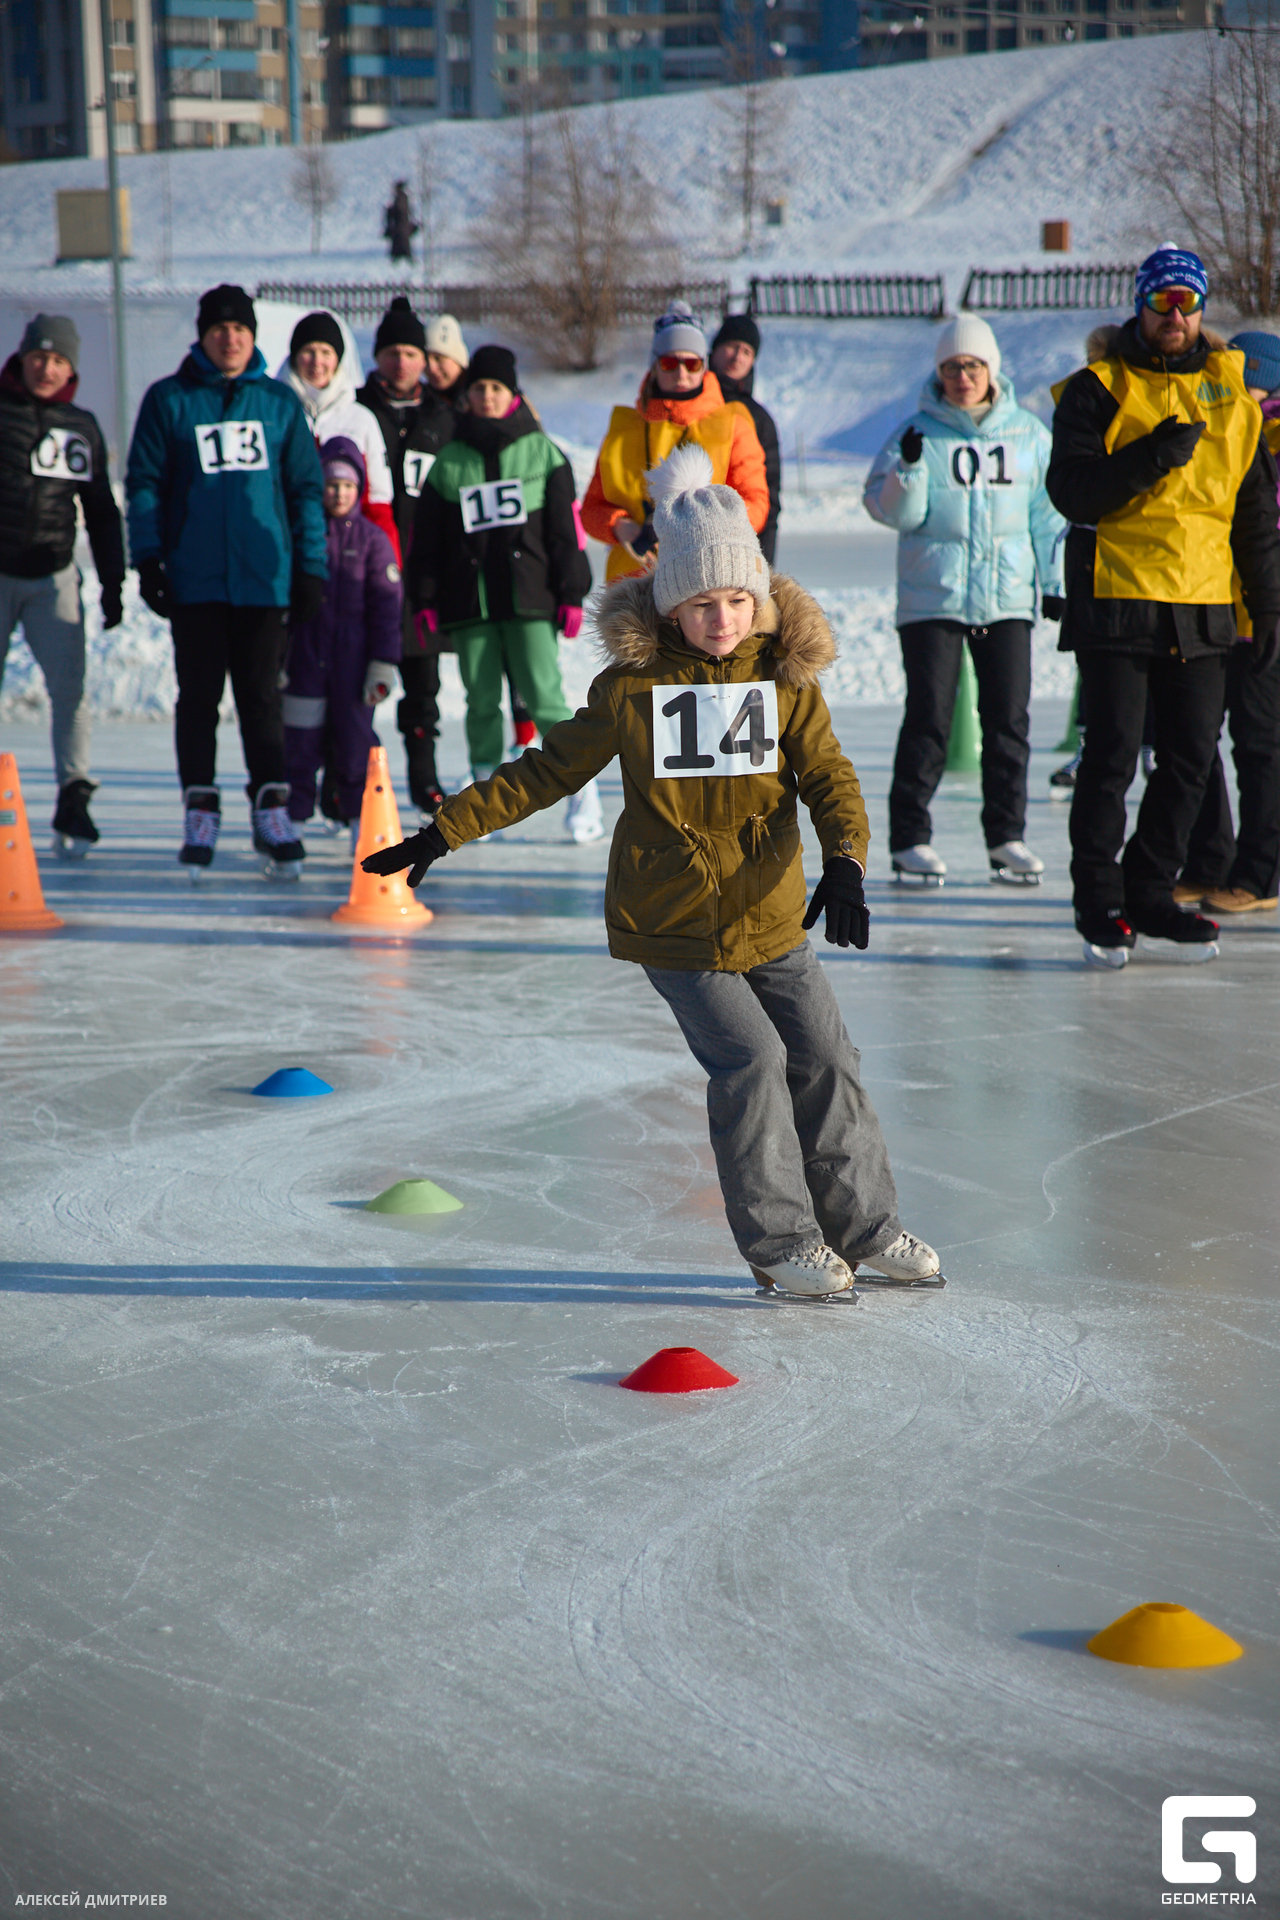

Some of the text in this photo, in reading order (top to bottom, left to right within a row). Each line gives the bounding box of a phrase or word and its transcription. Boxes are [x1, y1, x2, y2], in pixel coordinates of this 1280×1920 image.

[36, 431, 88, 473] 06
[204, 427, 262, 467] 13
[952, 446, 1012, 485] 01
[467, 484, 521, 526] 15
[662, 688, 775, 769] 14
